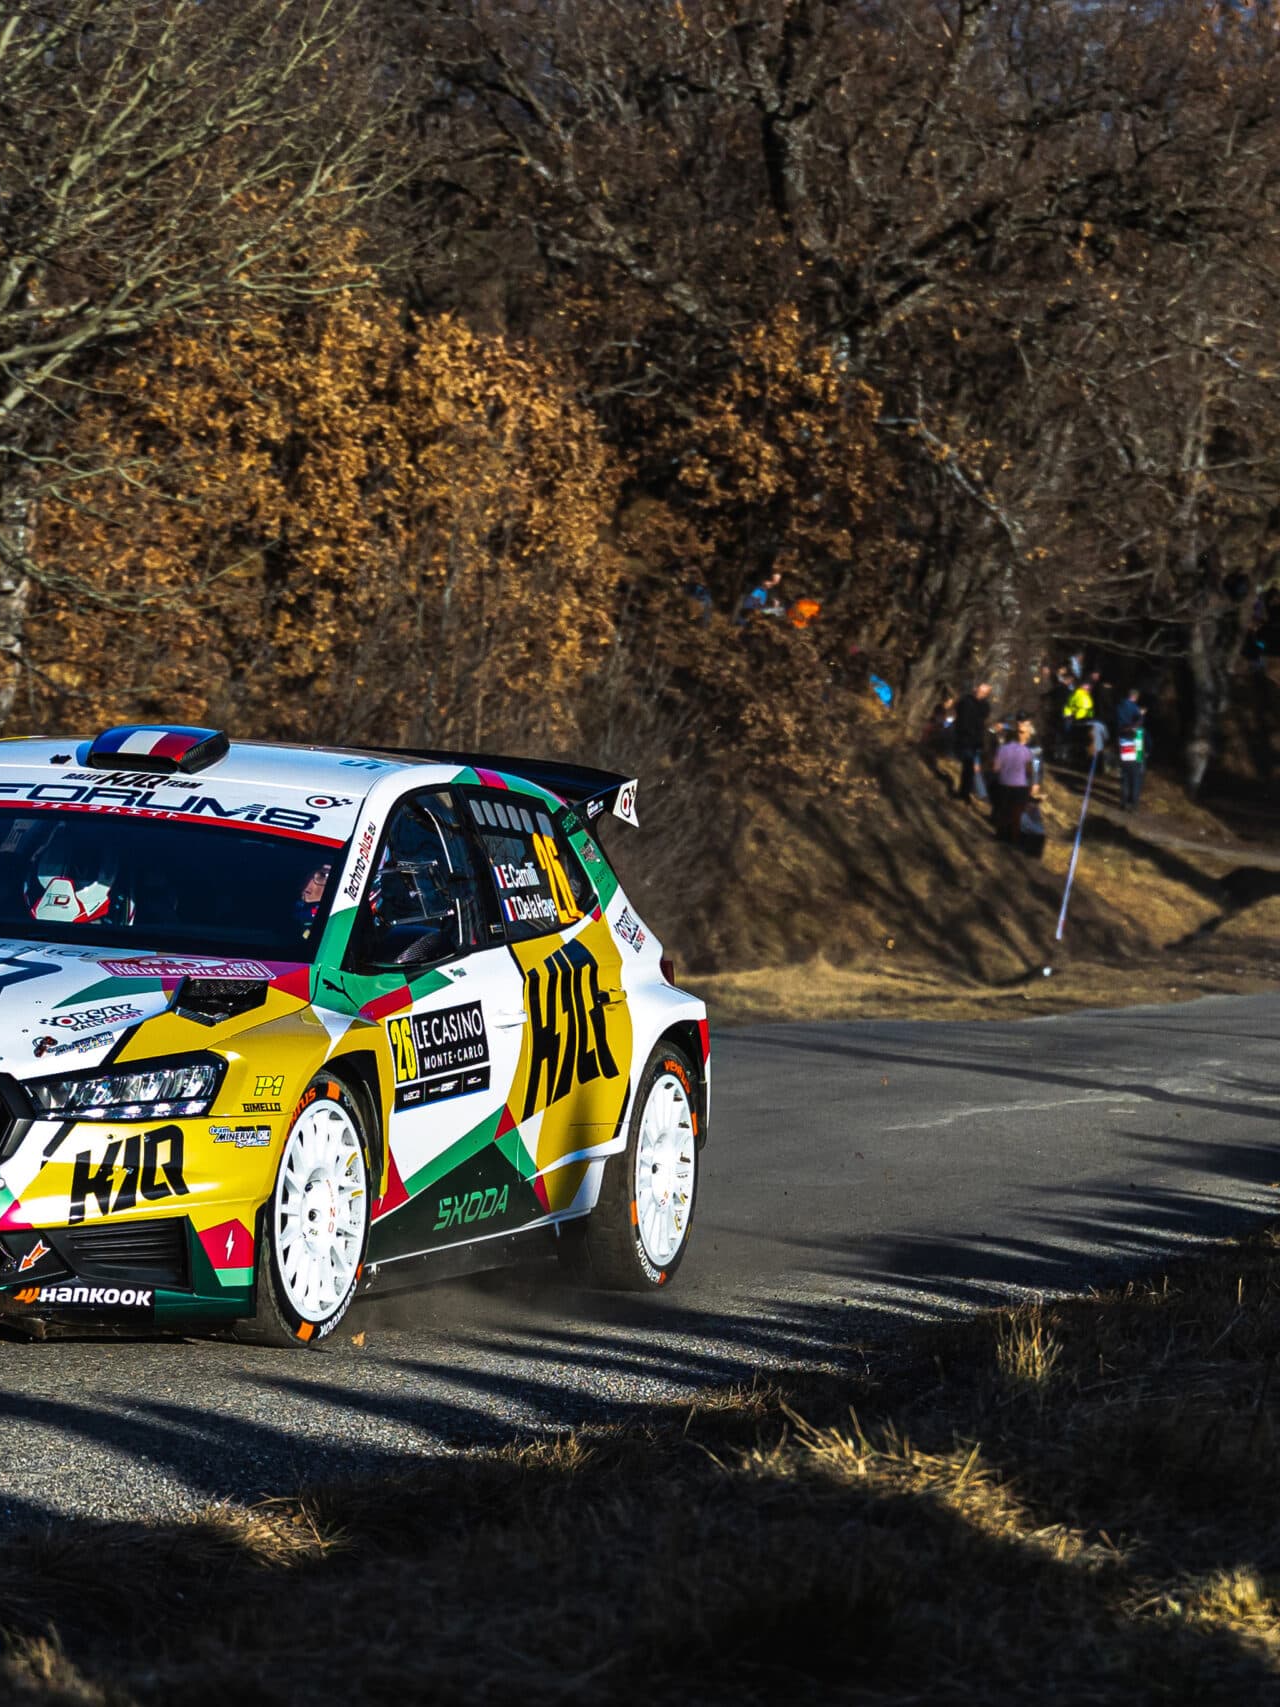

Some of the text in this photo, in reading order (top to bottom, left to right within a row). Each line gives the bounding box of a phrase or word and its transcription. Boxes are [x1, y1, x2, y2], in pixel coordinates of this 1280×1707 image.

[161, 779, 204, 789] TEAM
[32, 801, 179, 818] フォーラムエイト
[532, 832, 584, 924] 26
[111, 964, 164, 976] RALLYE
[55, 1003, 144, 1028] ORSAK
[414, 1008, 483, 1050] LE CASINO
[390, 1018, 417, 1081] 26
[254, 1075, 284, 1096] P1
[217, 1132, 255, 1141] MINERVA
